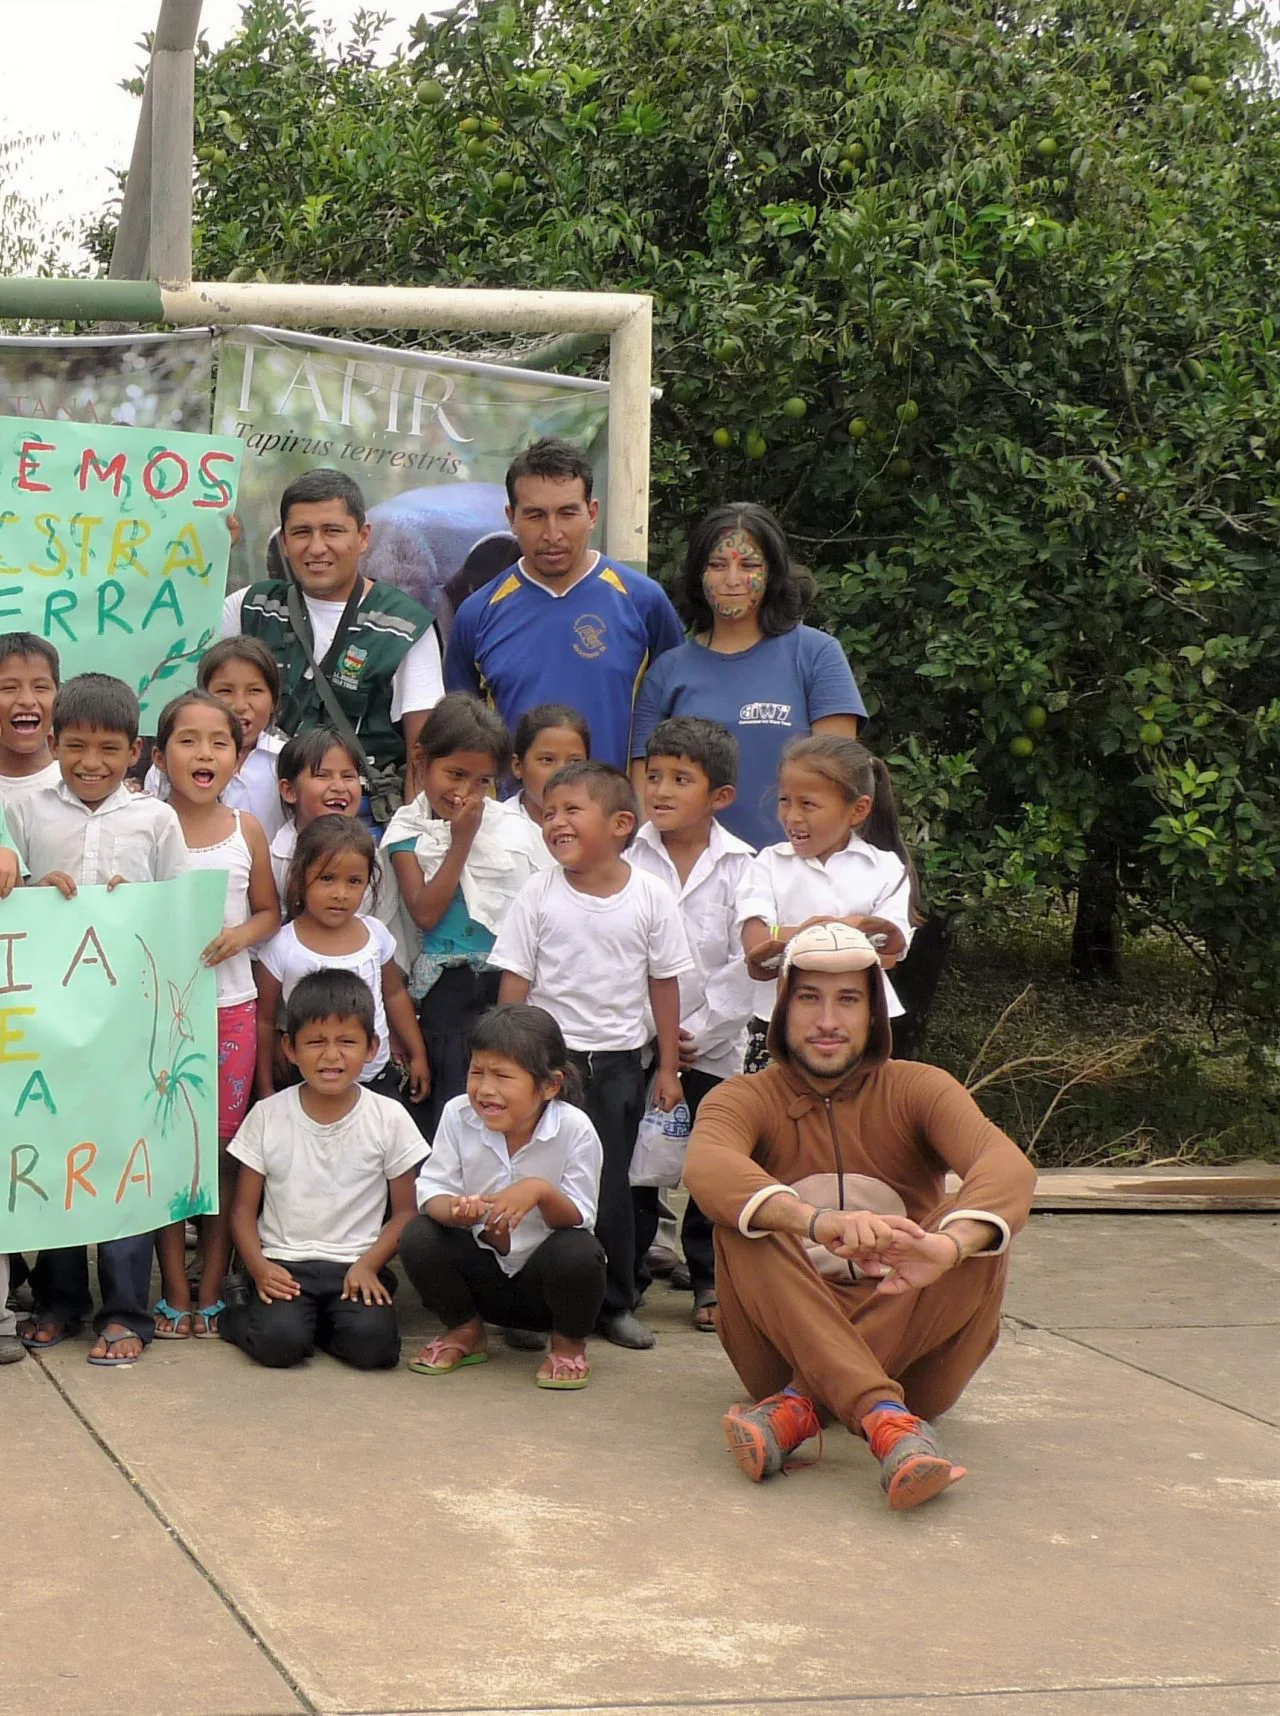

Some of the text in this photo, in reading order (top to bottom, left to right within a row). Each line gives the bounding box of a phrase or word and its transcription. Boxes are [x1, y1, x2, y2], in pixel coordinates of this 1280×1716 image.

[224, 339, 475, 443] TAPIR
[234, 422, 465, 475] Tapirus terrestris
